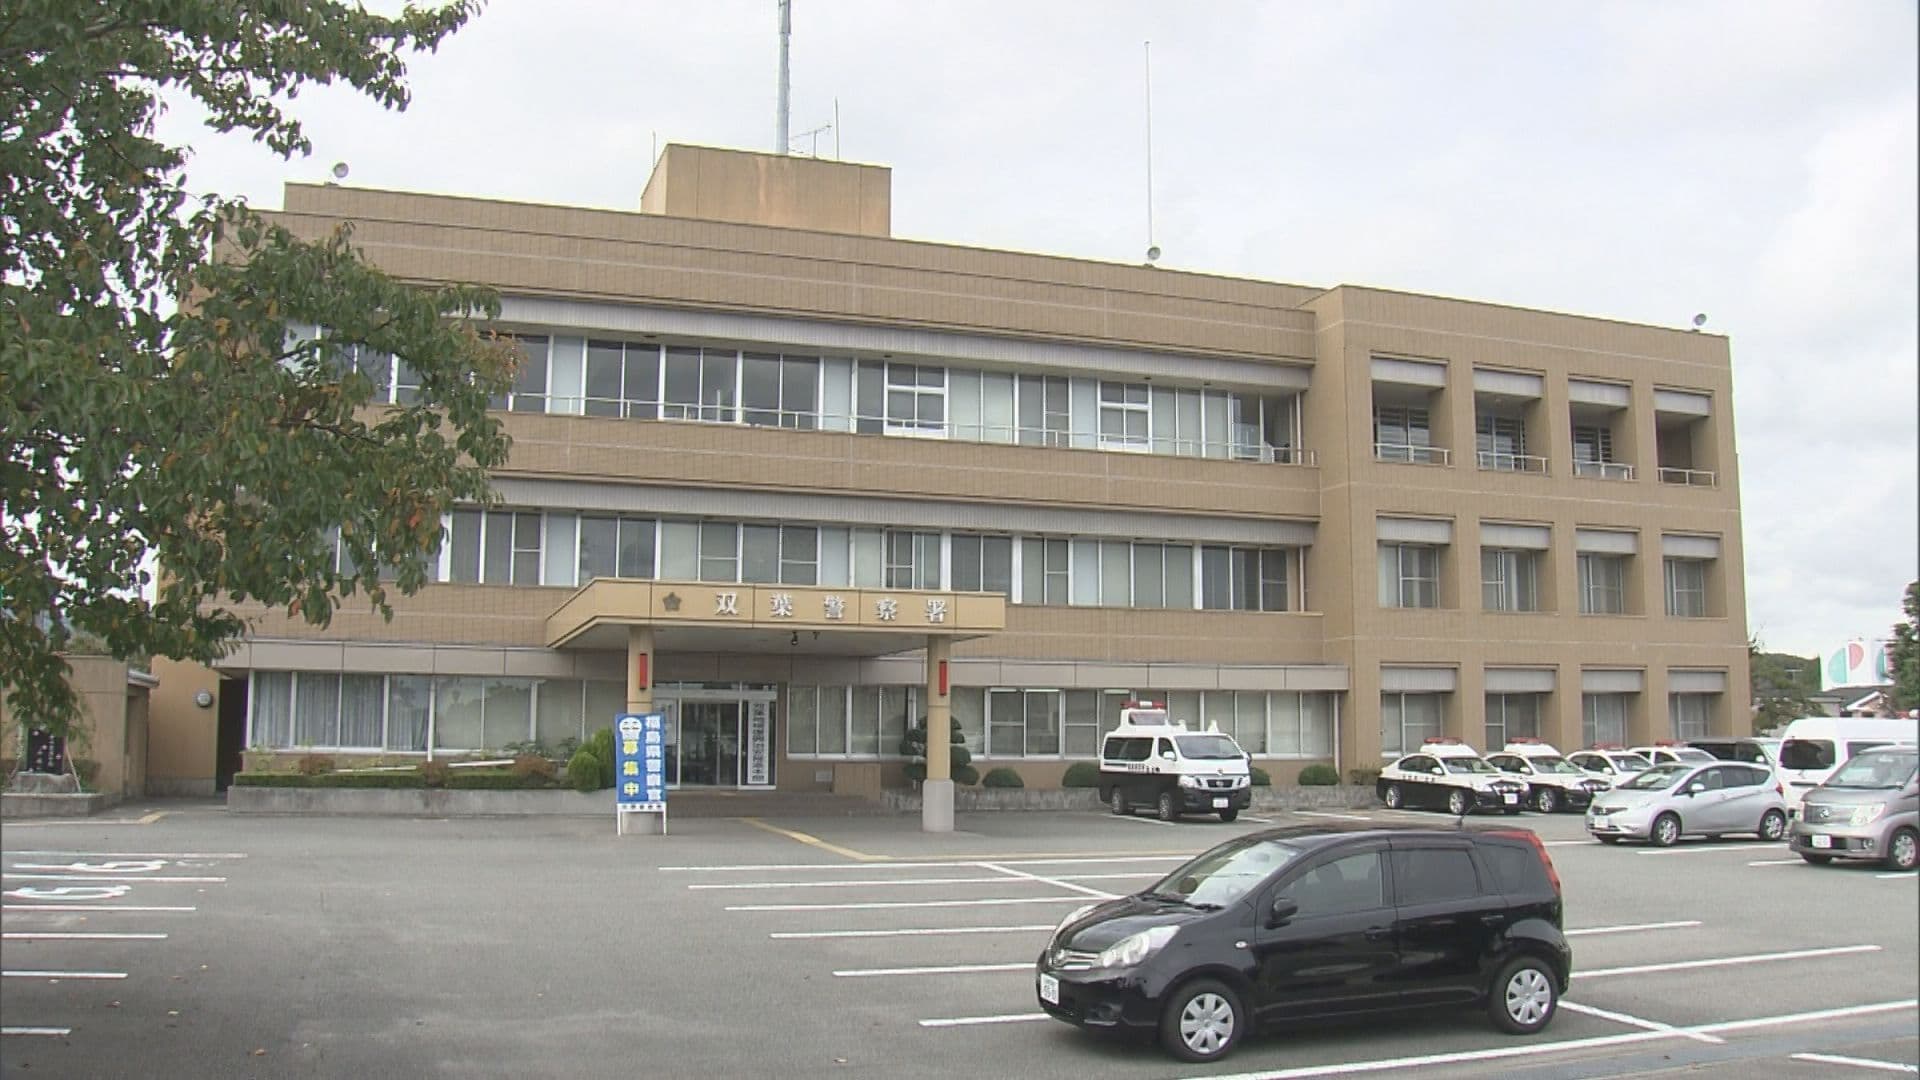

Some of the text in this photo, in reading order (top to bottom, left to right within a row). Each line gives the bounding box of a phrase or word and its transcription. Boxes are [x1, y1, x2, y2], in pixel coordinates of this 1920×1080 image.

[716, 593, 947, 623] 双葉警察署
[623, 740, 640, 797] 募集中
